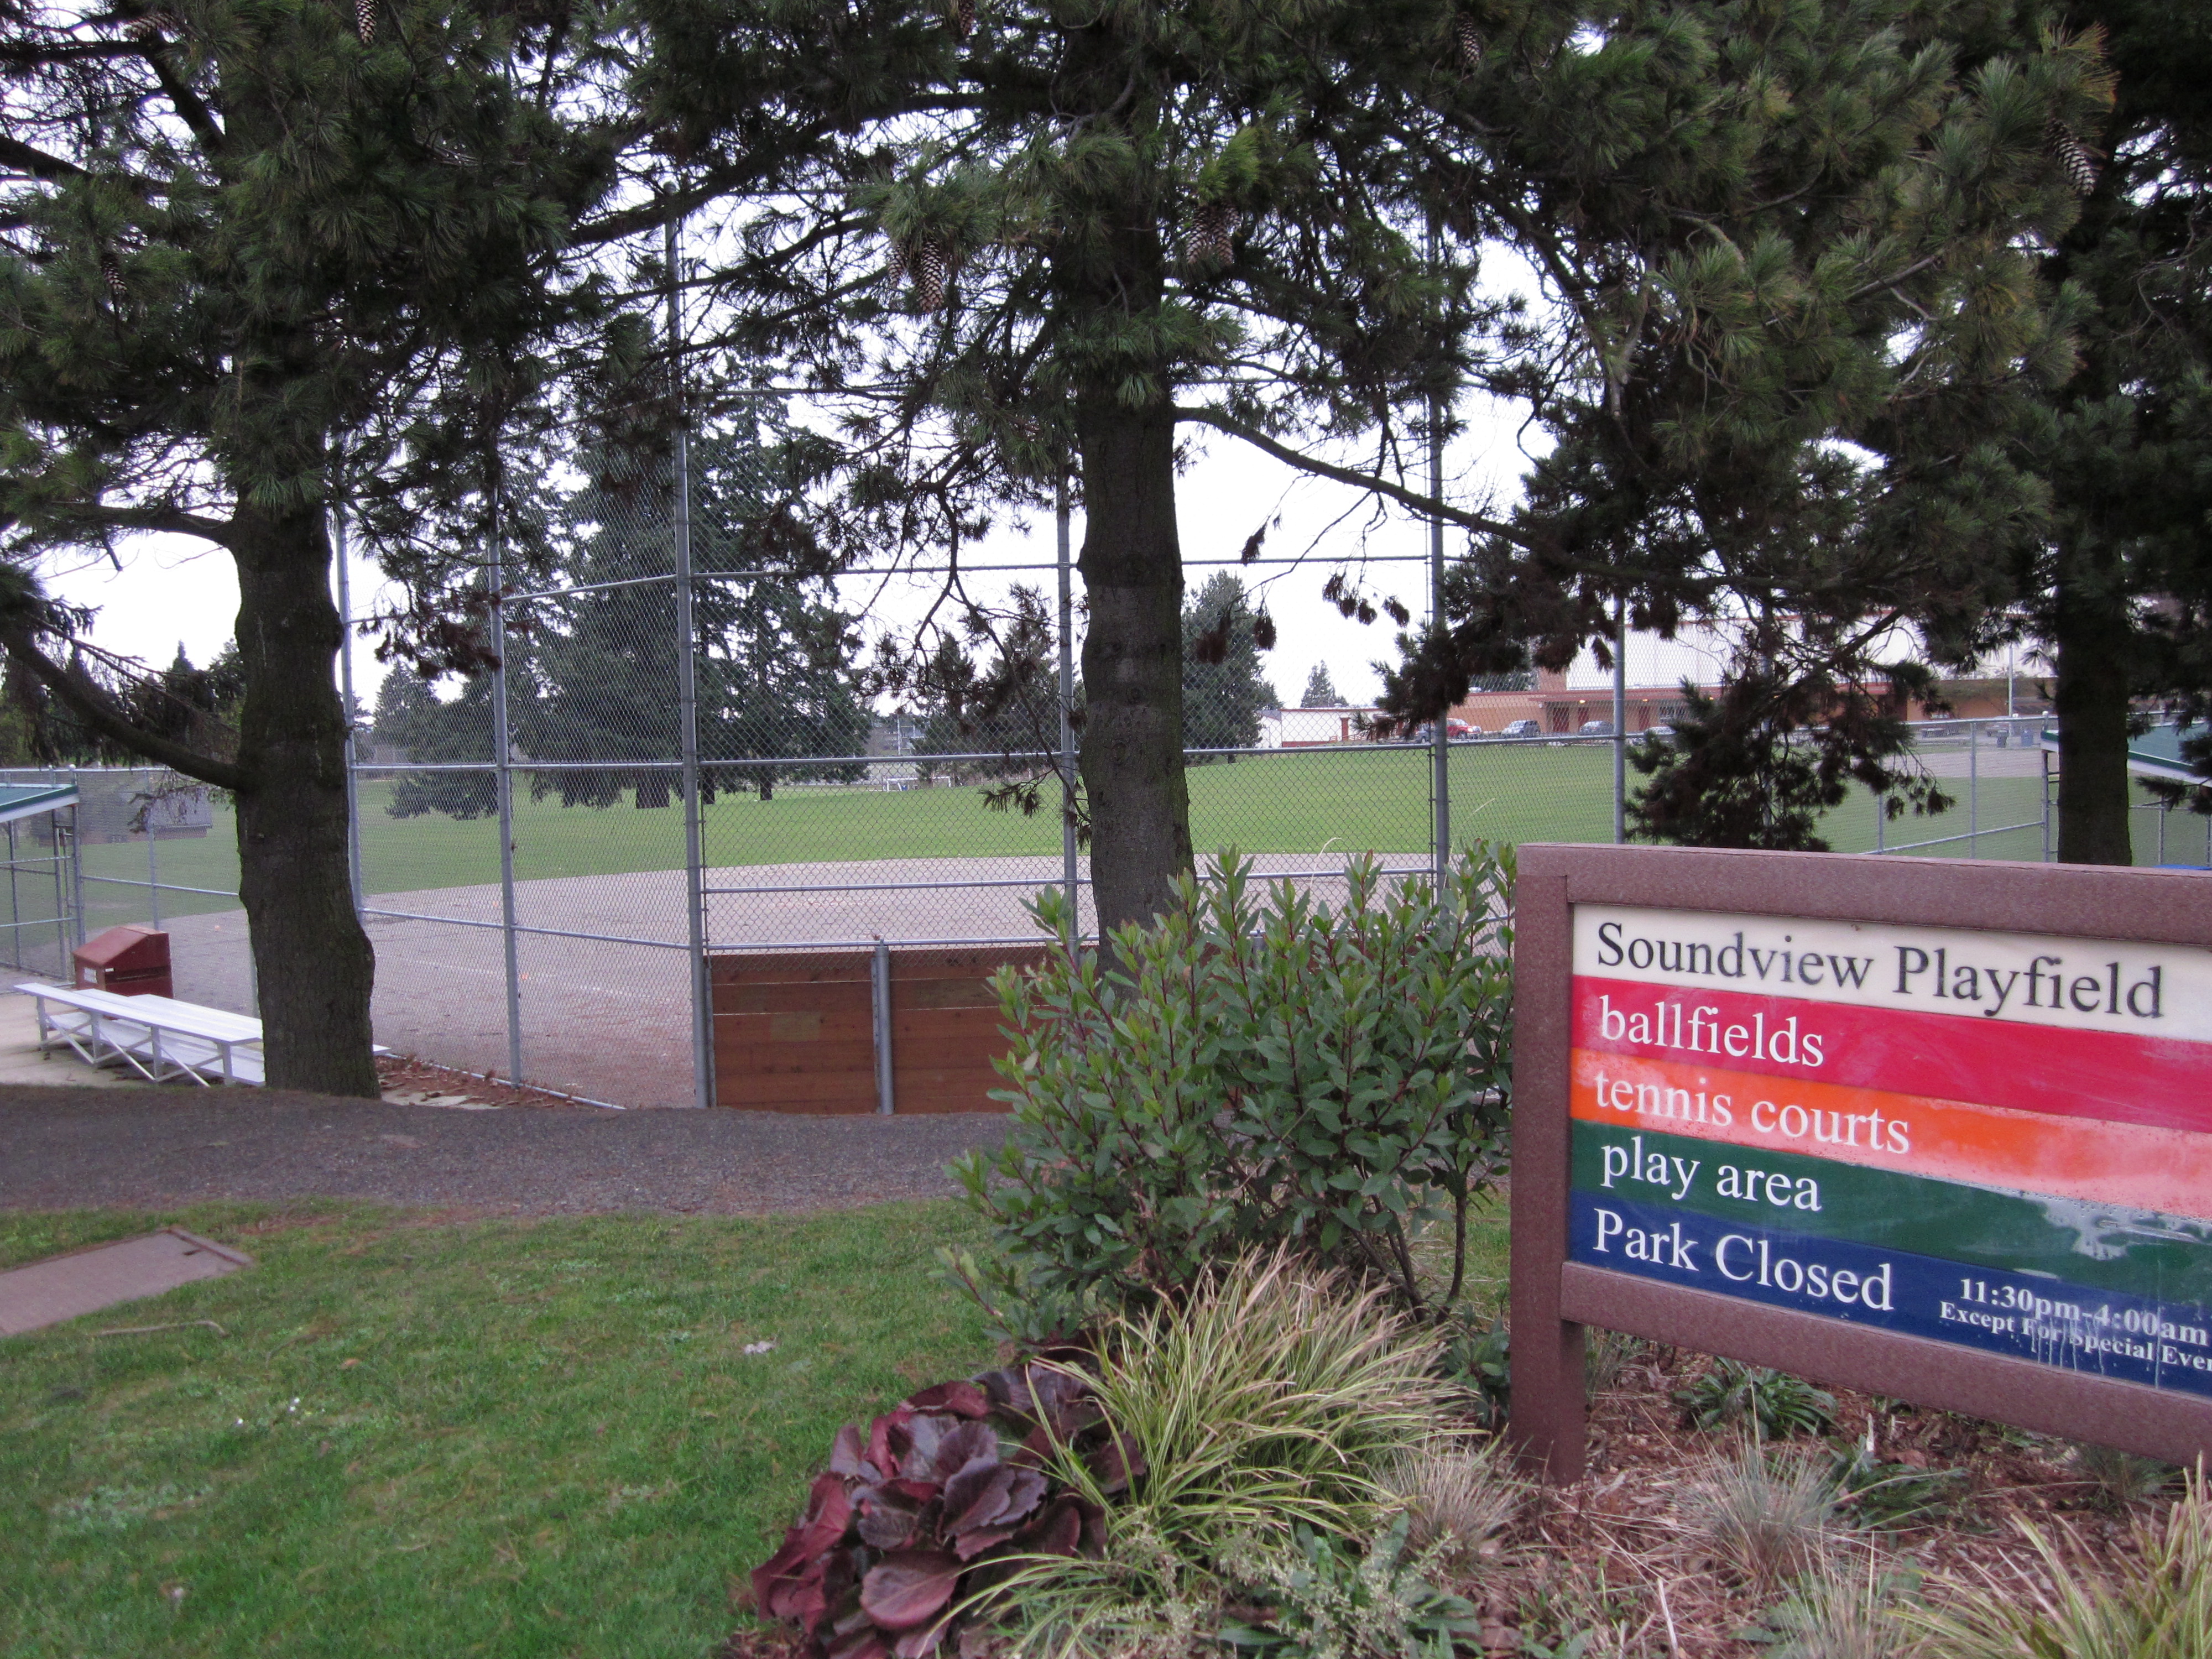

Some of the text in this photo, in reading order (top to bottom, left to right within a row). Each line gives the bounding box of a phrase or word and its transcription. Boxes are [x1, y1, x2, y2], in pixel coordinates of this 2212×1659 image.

[1598, 922, 2164, 1019] Soundview Playfield
[1599, 995, 1824, 1067] ballfields
[1594, 1071, 1910, 1154] tennis courts
[1600, 1136, 1822, 1212] play area
[1593, 1208, 1894, 1311] Park Closed
[1940, 1301, 2014, 1334] Except
[2021, 1317, 2063, 1342] For
[2069, 1328, 2153, 1361] Special
[1960, 1278, 2209, 1347] 11:30pm-4:00am
